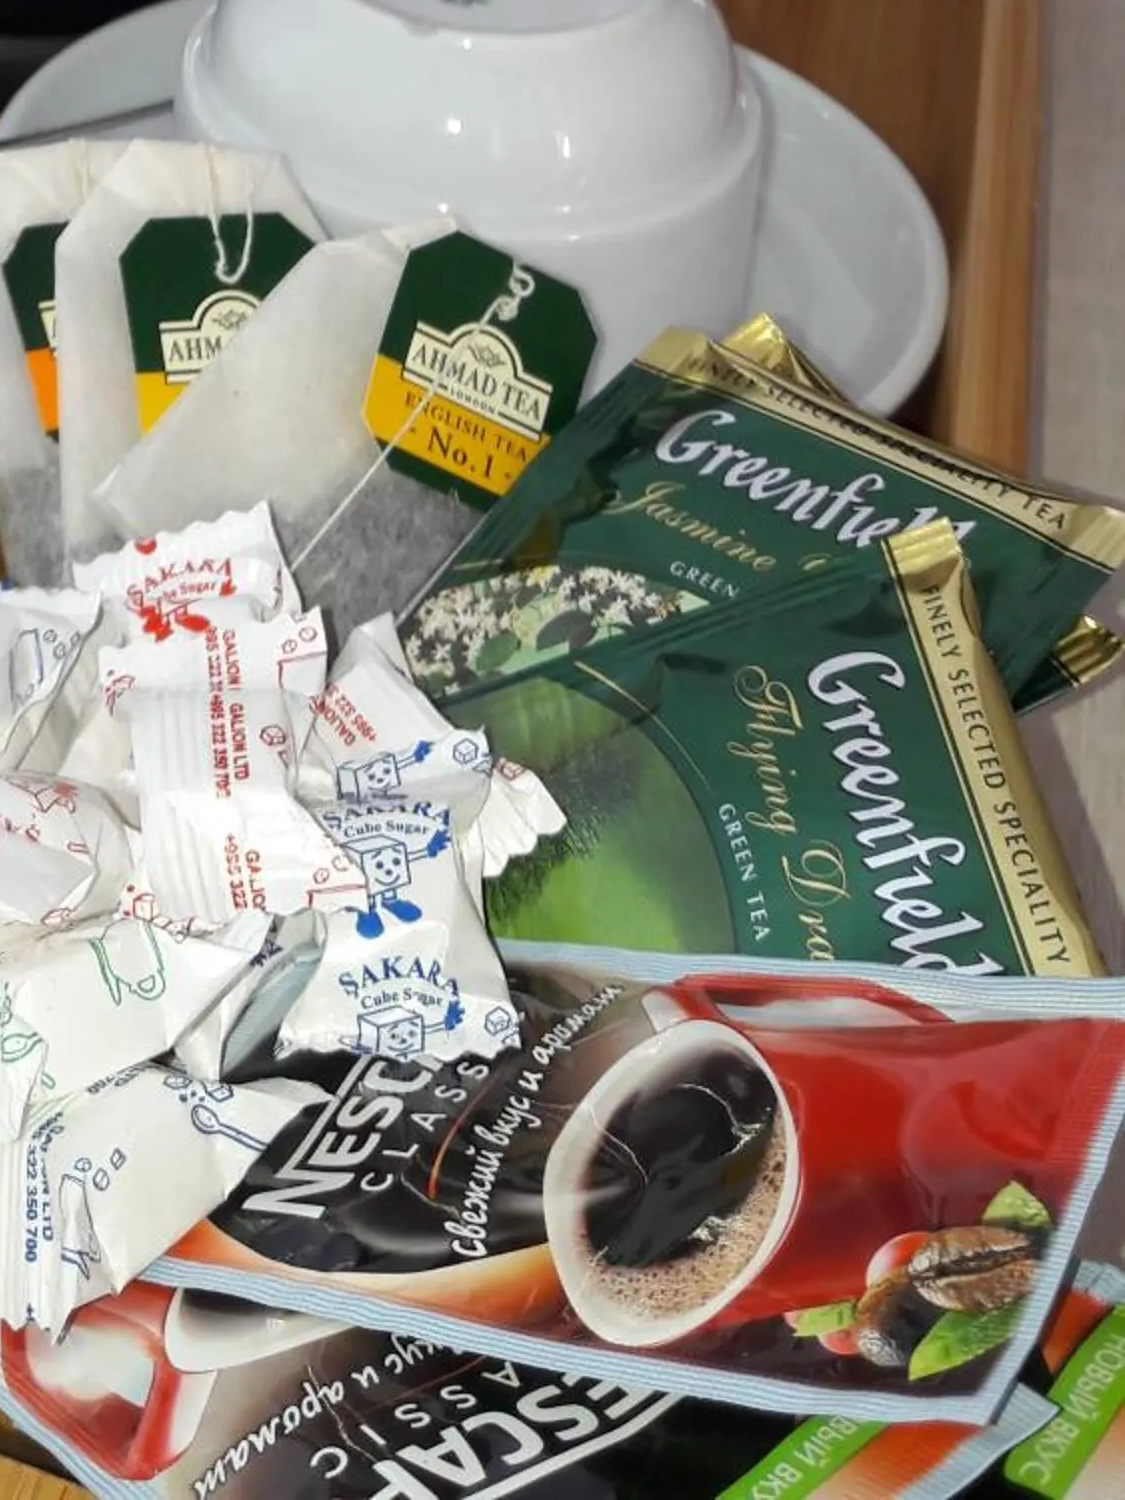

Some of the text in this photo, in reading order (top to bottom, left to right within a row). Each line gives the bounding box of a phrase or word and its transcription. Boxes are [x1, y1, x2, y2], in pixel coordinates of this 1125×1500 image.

[168, 336, 223, 363] AHM
[412, 344, 541, 421] AHMAD TEA
[404, 390, 528, 463] ENGLISH TEA
[604, 480, 777, 572] Jasmine
[1020, 492, 1066, 530] TEA
[669, 560, 741, 597] GREEN
[228, 702, 248, 753] GALION
[232, 754, 251, 782] LTD
[921, 583, 1072, 966] FINELY SELECTED SPECIALITY
[343, 819, 427, 839] Cube Sugar
[718, 803, 771, 943] GREEN TEA
[338, 955, 461, 999] SAKARA
[360, 990, 399, 1009] Cube
[531, 984, 627, 1067] аромат
[518, 1070, 545, 1095] и
[242, 1050, 445, 1221] NESC
[360, 1060, 490, 1193] CLASS
[481, 1097, 544, 1158] вкус
[25, 1185, 39, 1221] 350
[42, 1202, 55, 1243] LTD
[24, 1225, 39, 1264] 700
[350, 1369, 381, 1391] и
[192, 1377, 347, 1500] аромат
[310, 1360, 522, 1480] ASSIC
[797, 1414, 861, 1468] ВЫЙ
[1017, 1417, 1082, 1486] ВКУС
